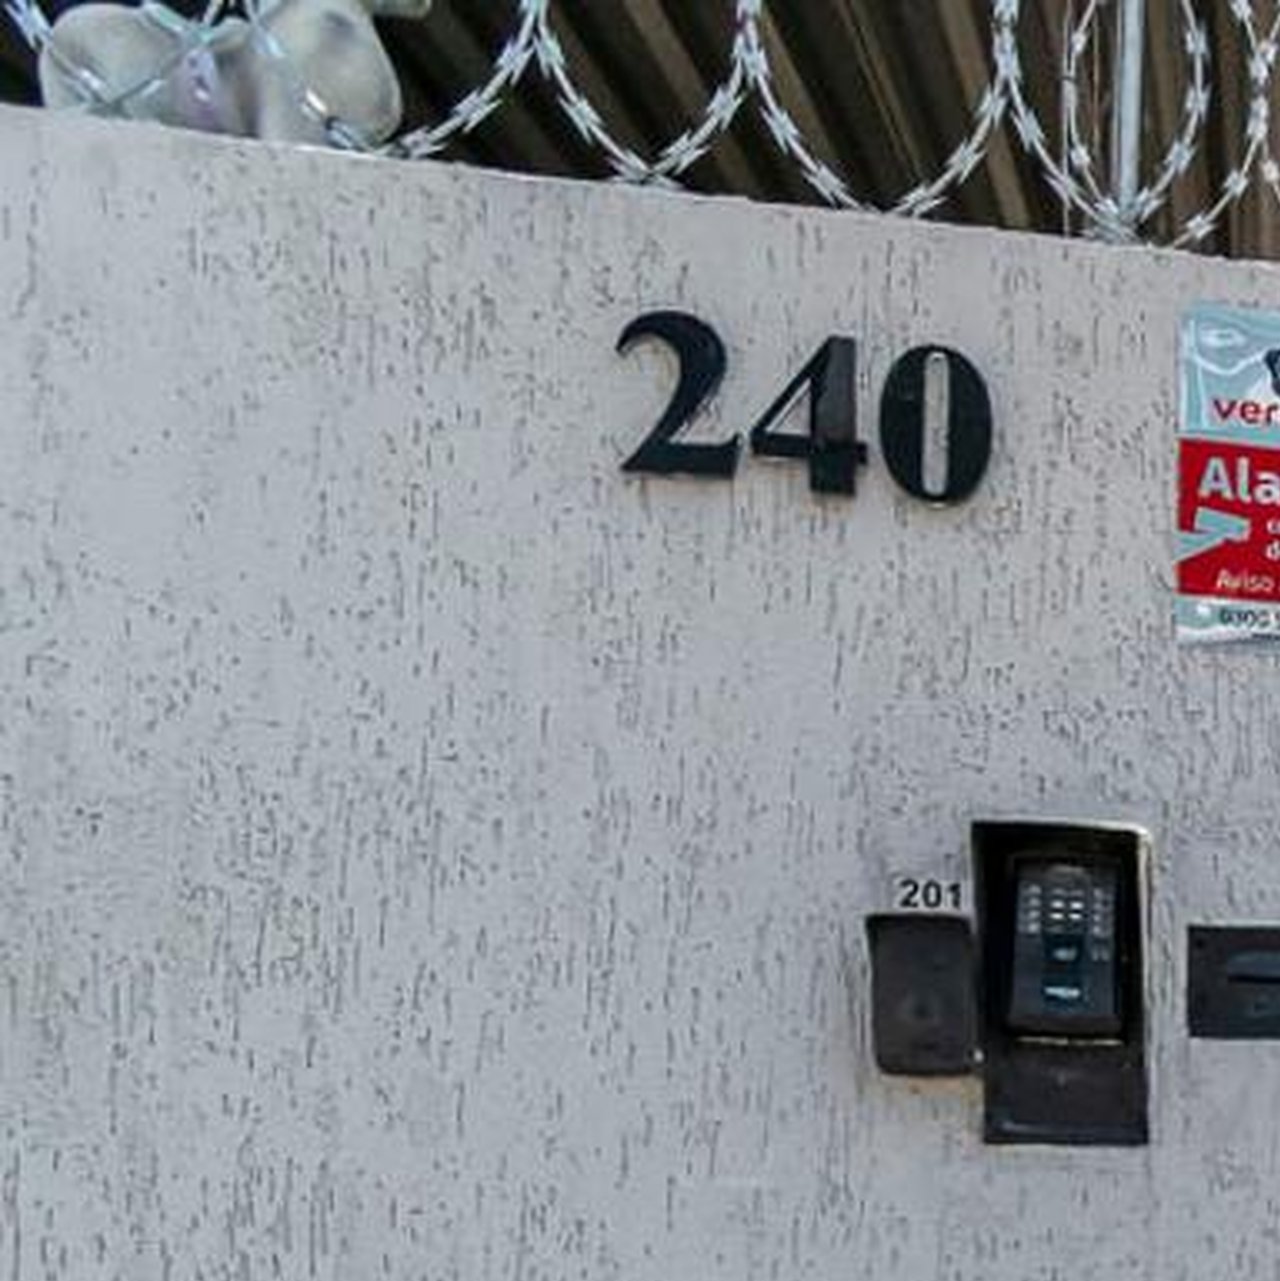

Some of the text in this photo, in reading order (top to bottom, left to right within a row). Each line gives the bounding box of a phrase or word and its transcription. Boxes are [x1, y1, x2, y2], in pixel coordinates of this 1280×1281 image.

[614, 310, 993, 508] 240
[1216, 568, 1274, 593] Aviso
[899, 879, 963, 909] 201
